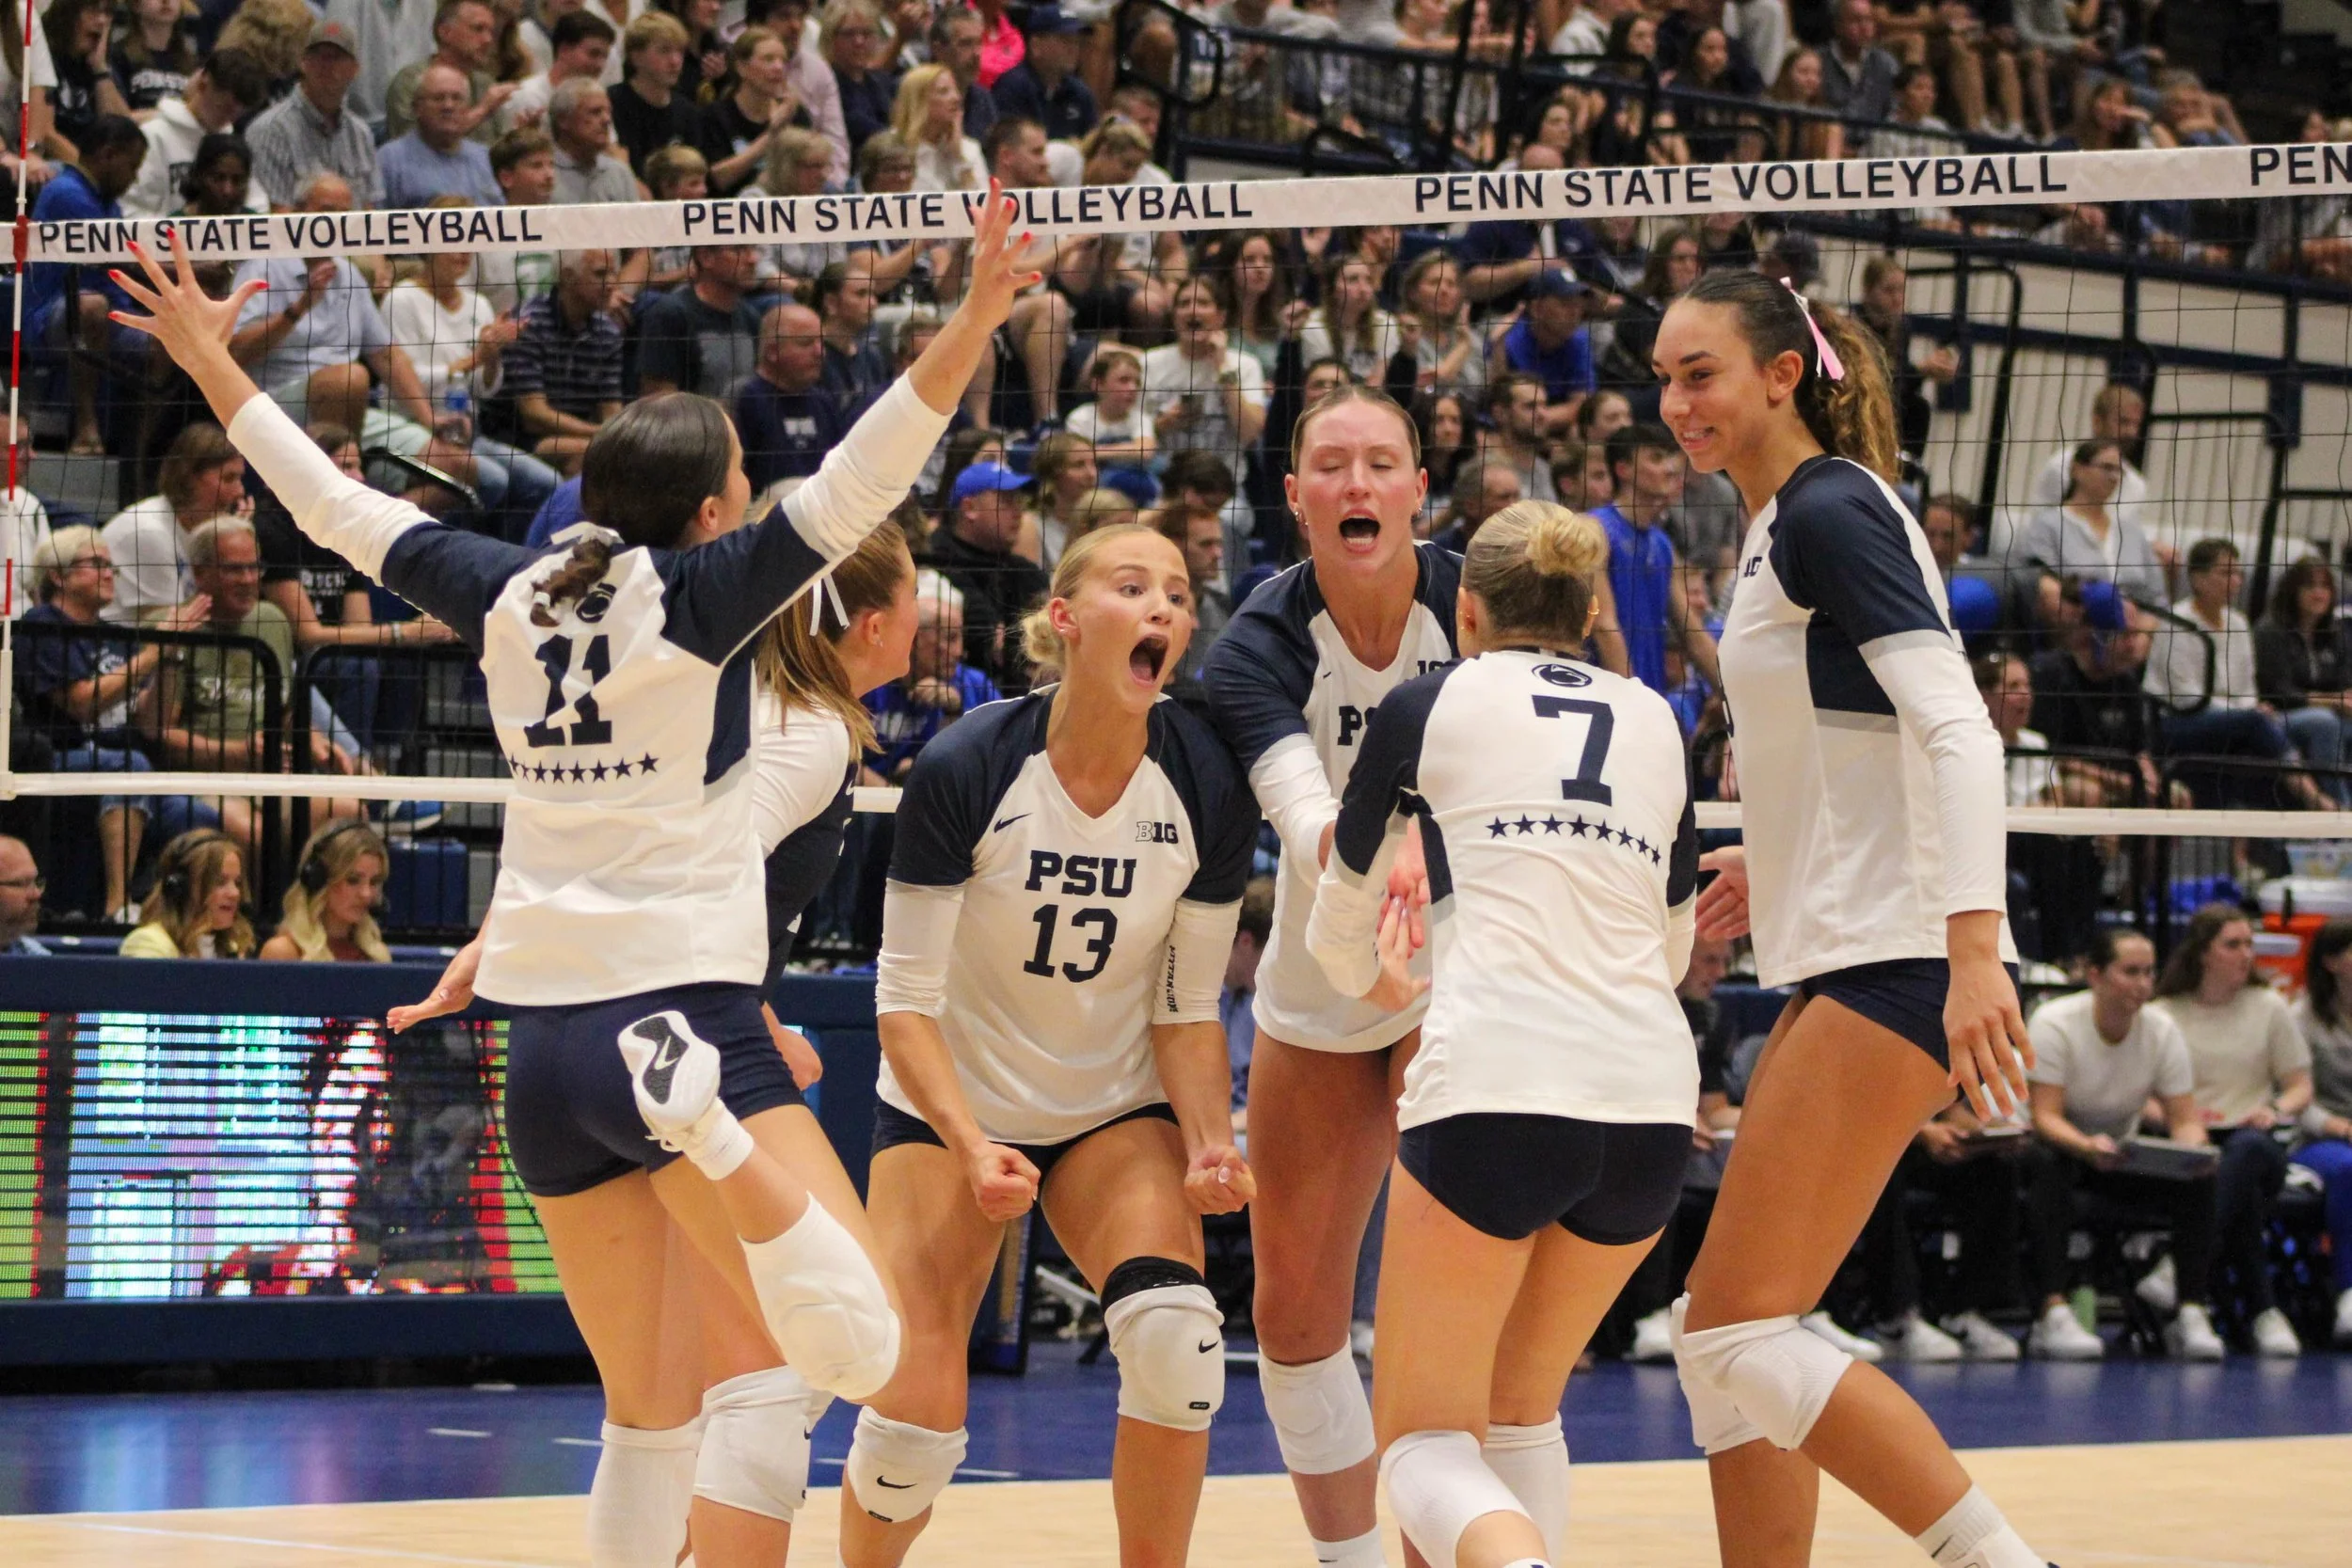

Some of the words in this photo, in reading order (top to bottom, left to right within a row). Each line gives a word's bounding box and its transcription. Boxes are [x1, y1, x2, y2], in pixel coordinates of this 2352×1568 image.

[1415, 173, 1544, 213] PENN
[1565, 166, 1712, 207] STATE
[1731, 155, 2068, 200] VOLLEYBALL
[39, 222, 138, 253] PENN
[154, 218, 270, 252] STATE
[284, 210, 543, 248] VOLLEYBALL
[683, 199, 796, 235] PENN
[815, 194, 945, 231] STATE
[523, 634, 612, 748] 11
[1532, 694, 1614, 807] 7
[1025, 849, 1136, 898] PSU
[1024, 904, 1118, 983] 13
